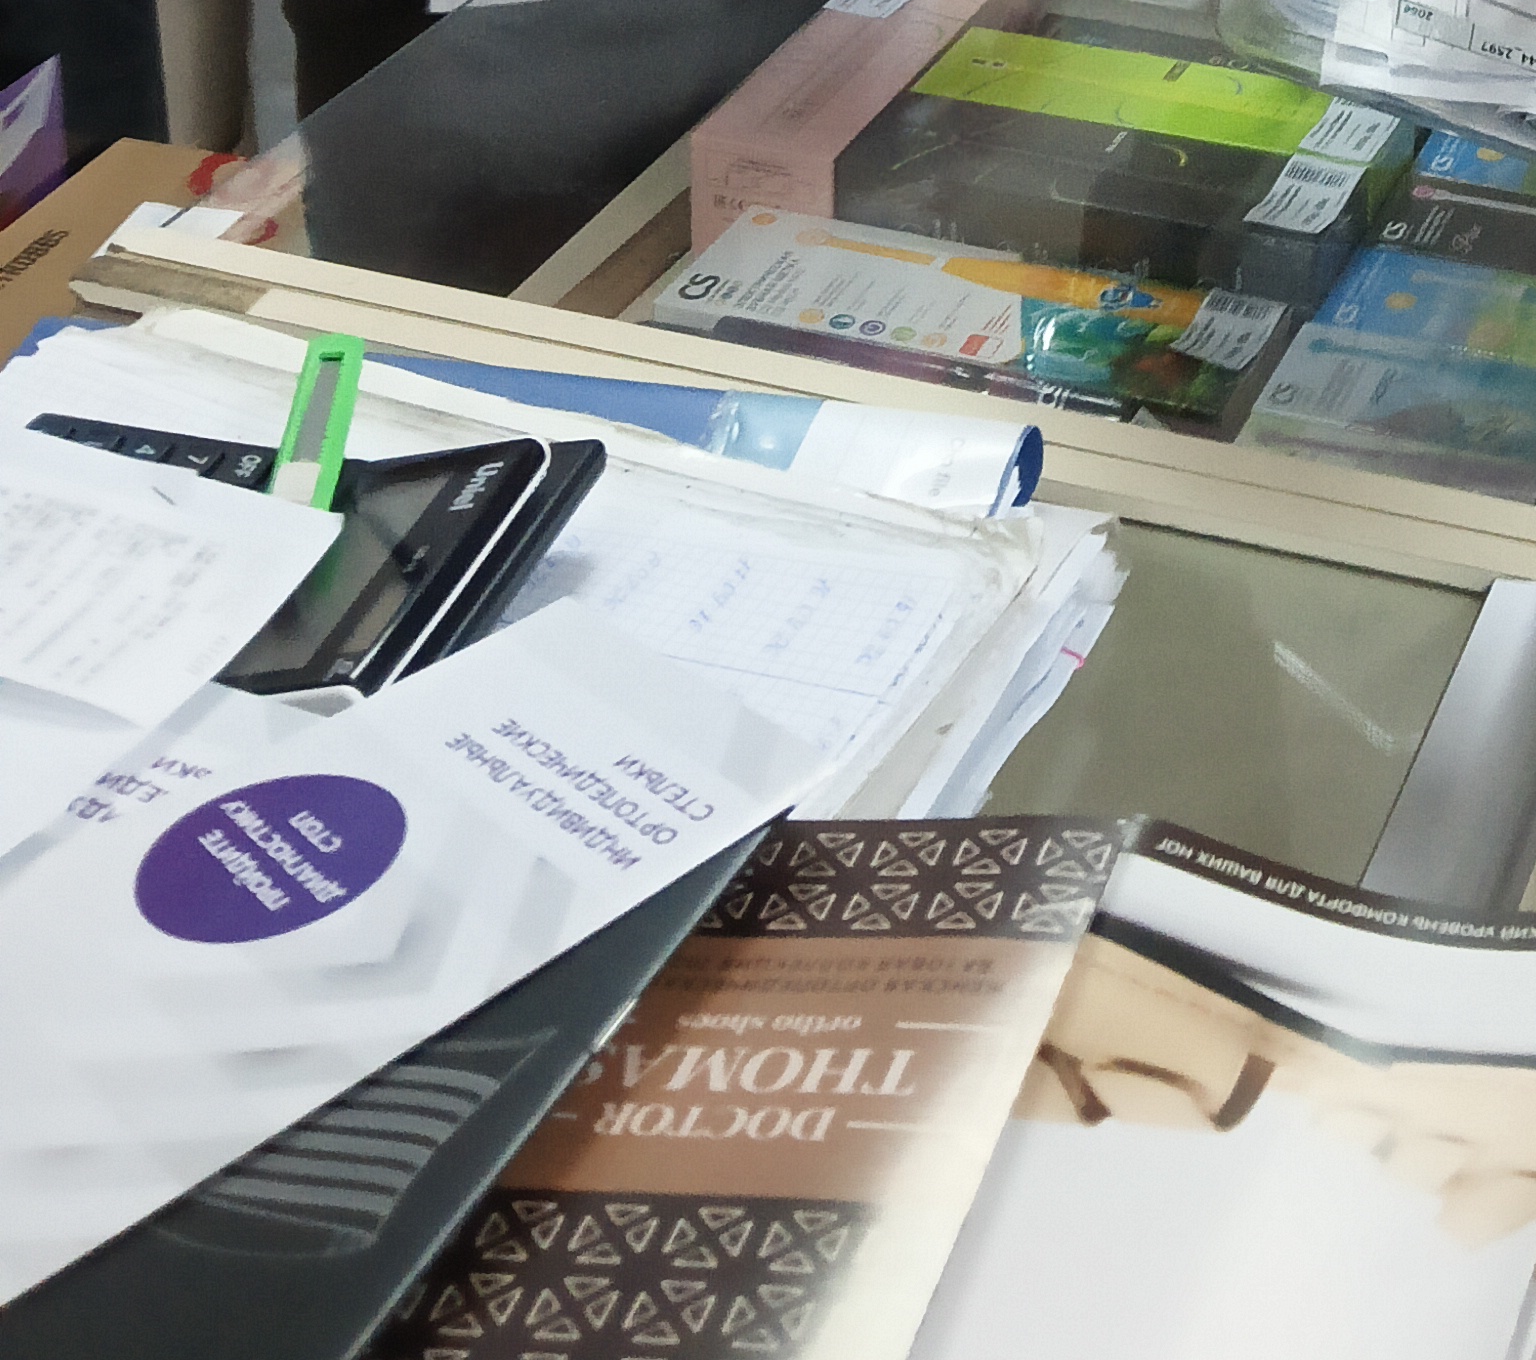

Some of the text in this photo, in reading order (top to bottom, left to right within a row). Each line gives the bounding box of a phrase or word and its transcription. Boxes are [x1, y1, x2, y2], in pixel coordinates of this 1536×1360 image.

[444, 732, 643, 871] ИНДИВИДУАЛЬНЫЕ
[491, 718, 679, 845] ОРТОПЕДИЧЕСКИЕ
[612, 753, 715, 822] СТЕЛЬКИ
[1154, 836, 1194, 860] НОГ
[593, 1101, 837, 1143] DOCTOR
